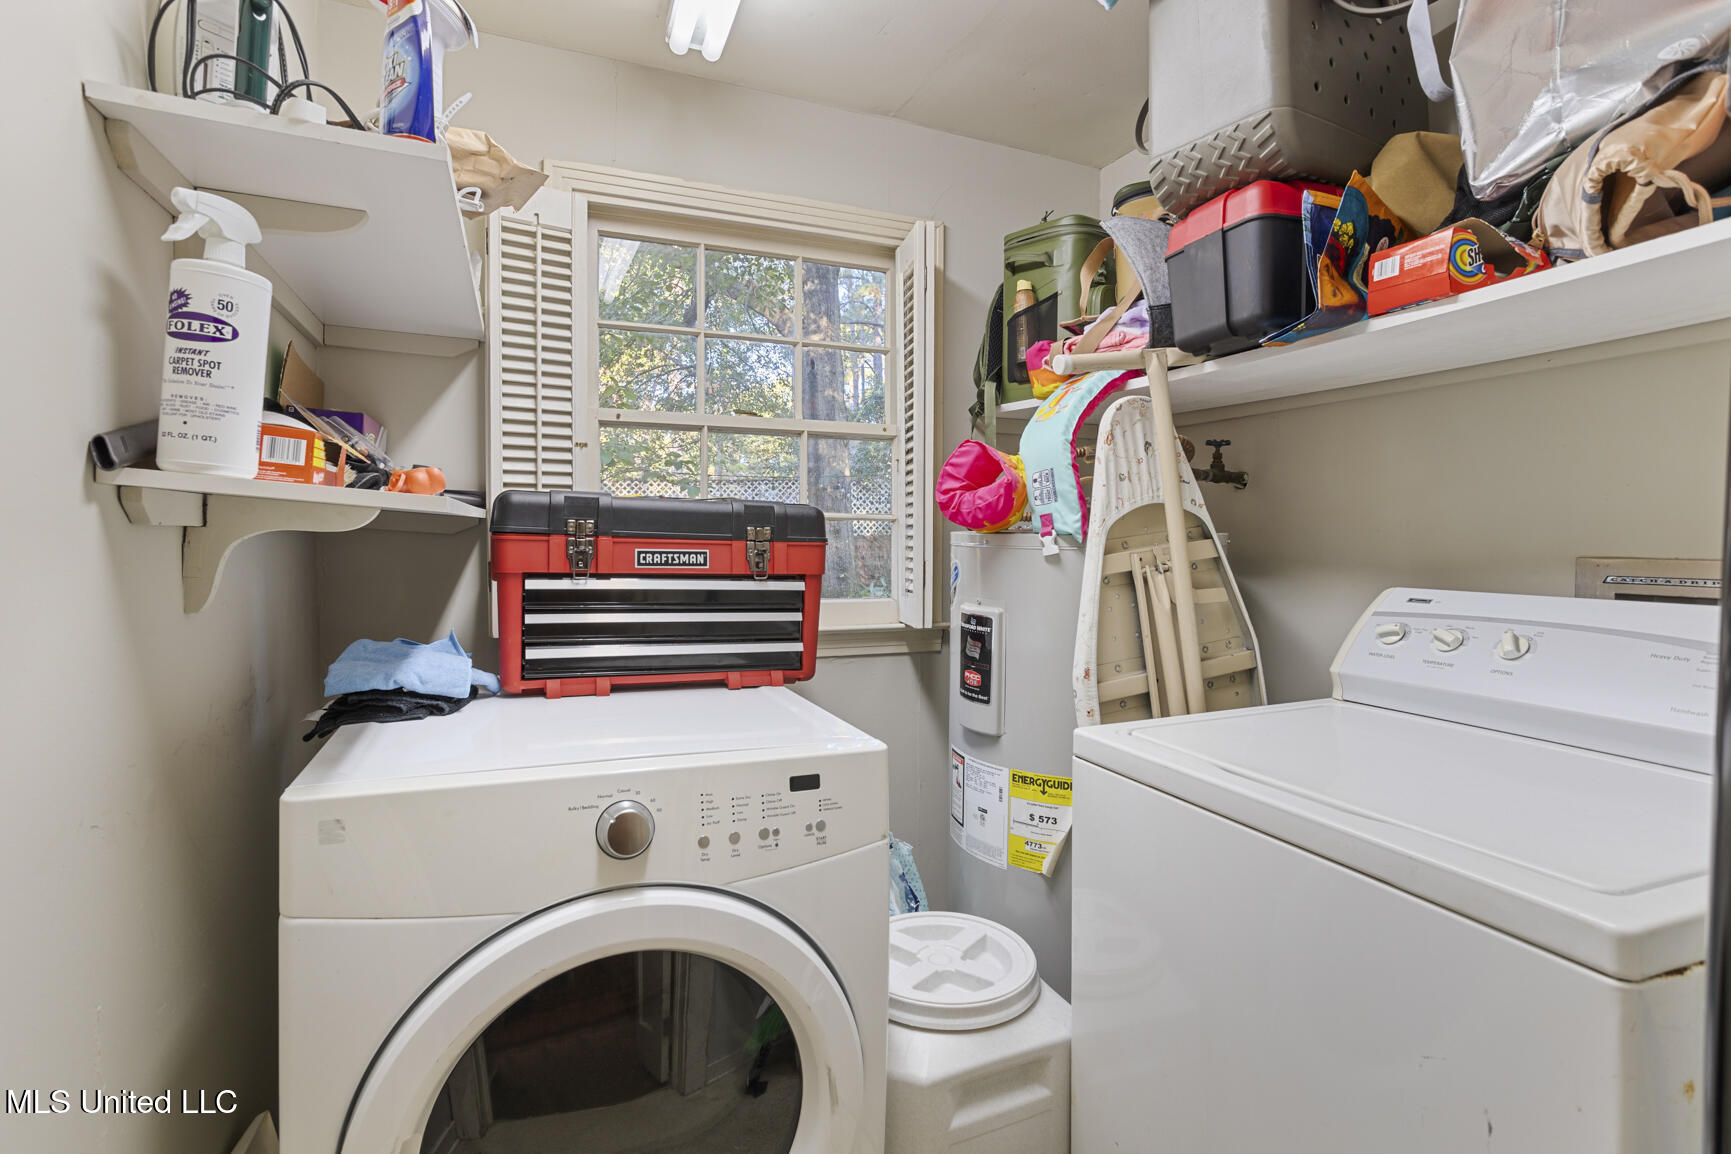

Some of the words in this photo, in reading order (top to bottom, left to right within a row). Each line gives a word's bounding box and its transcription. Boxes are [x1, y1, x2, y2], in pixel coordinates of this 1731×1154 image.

[217, 299, 234, 312] 50
[168, 320, 225, 337] FOLEX
[175, 346, 210, 356] INSTANT
[169, 355, 195, 366] CARPET
[197, 358, 222, 370] SPOT
[172, 366, 212, 379] REMOVER
[639, 553, 704, 564] CRAFTSMAN
[1029, 813, 1035, 822] $
[1038, 815, 1057, 825] 573
[1025, 840, 1042, 849] 4773
